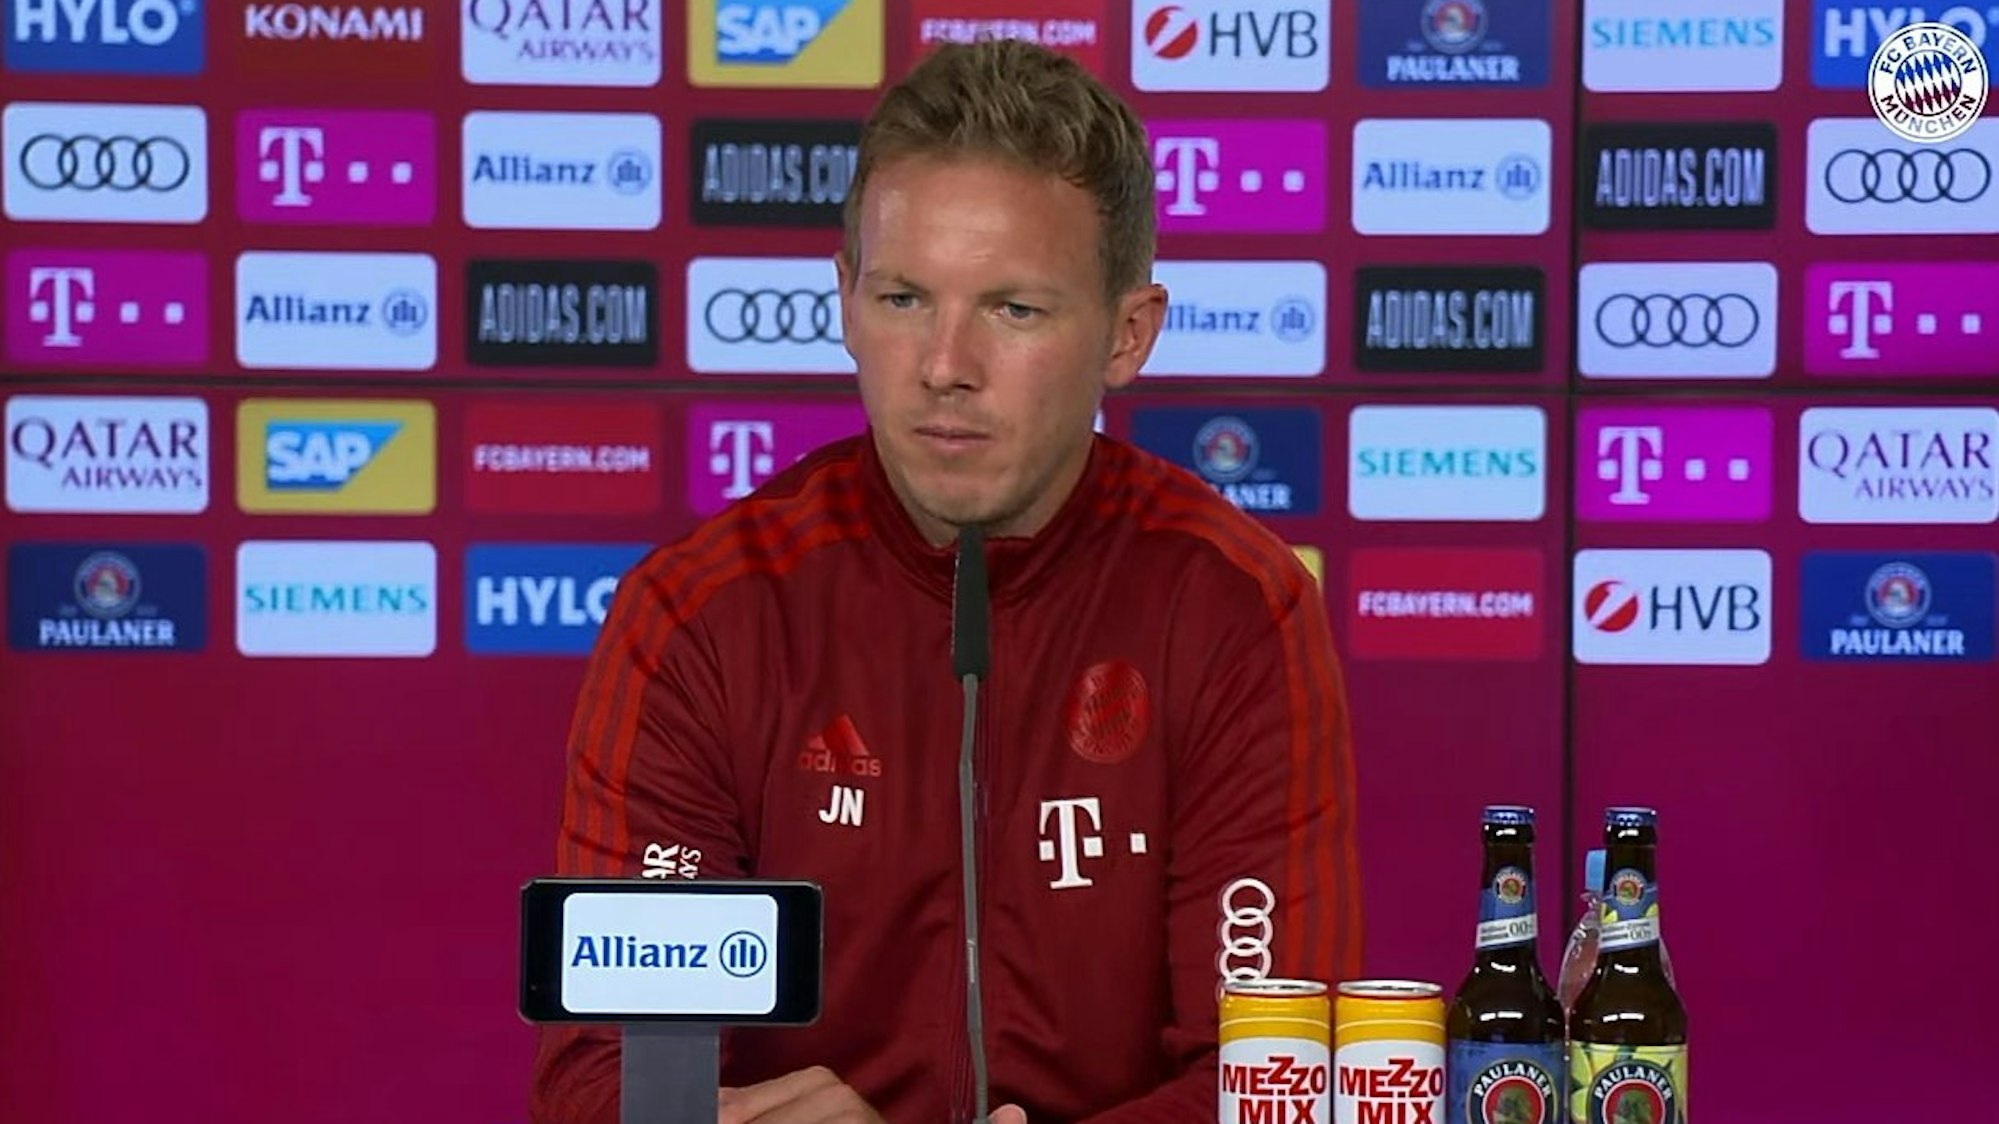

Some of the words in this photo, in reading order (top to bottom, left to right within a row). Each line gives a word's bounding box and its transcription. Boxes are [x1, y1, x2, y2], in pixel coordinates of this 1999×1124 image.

[245, 4, 423, 41] KONAMI
[716, 4, 821, 55] SAP
[1209, 10, 1318, 58] HVB
[1591, 18, 1775, 49] SIEMENS
[517, 39, 655, 61] AIRWAYS
[1387, 55, 1519, 81] PAULANER
[472, 154, 595, 184] Allianz
[1363, 161, 1484, 190] Allianz
[1596, 147, 1765, 207] ADIDAS.COM
[245, 294, 370, 325] Allianz
[479, 283, 647, 344] ADIDAS.COM
[1167, 304, 1261, 332] llianz
[1366, 290, 1534, 349] ADIDAS.COM
[12, 417, 198, 469] QATAR
[266, 429, 373, 483] SAP
[474, 444, 650, 472] FCBAYERN.COM
[1807, 430, 1991, 478] QATAR
[61, 465, 202, 489] AIRWAYS
[1357, 449, 1537, 477] SIEMENS
[1854, 476, 1994, 500] AIRWAYS
[245, 586, 428, 612] SIEMENS
[1358, 591, 1534, 618] FCBAYERN.COM
[1650, 585, 1761, 631] HVB
[39, 619, 174, 646] PAULANER
[1830, 629, 1965, 656] PAULANER
[818, 785, 865, 827] JN
[572, 935, 708, 968] Allianz
[1222, 1056, 1327, 1096] MEZZO
[1339, 1058, 1444, 1098] MEZZO
[1473, 1062, 1553, 1098] PAULANER
[1593, 1065, 1674, 1100] PAULANER
[1238, 1098, 1316, 1124] MIX
[1357, 1100, 1434, 1124] MIX
